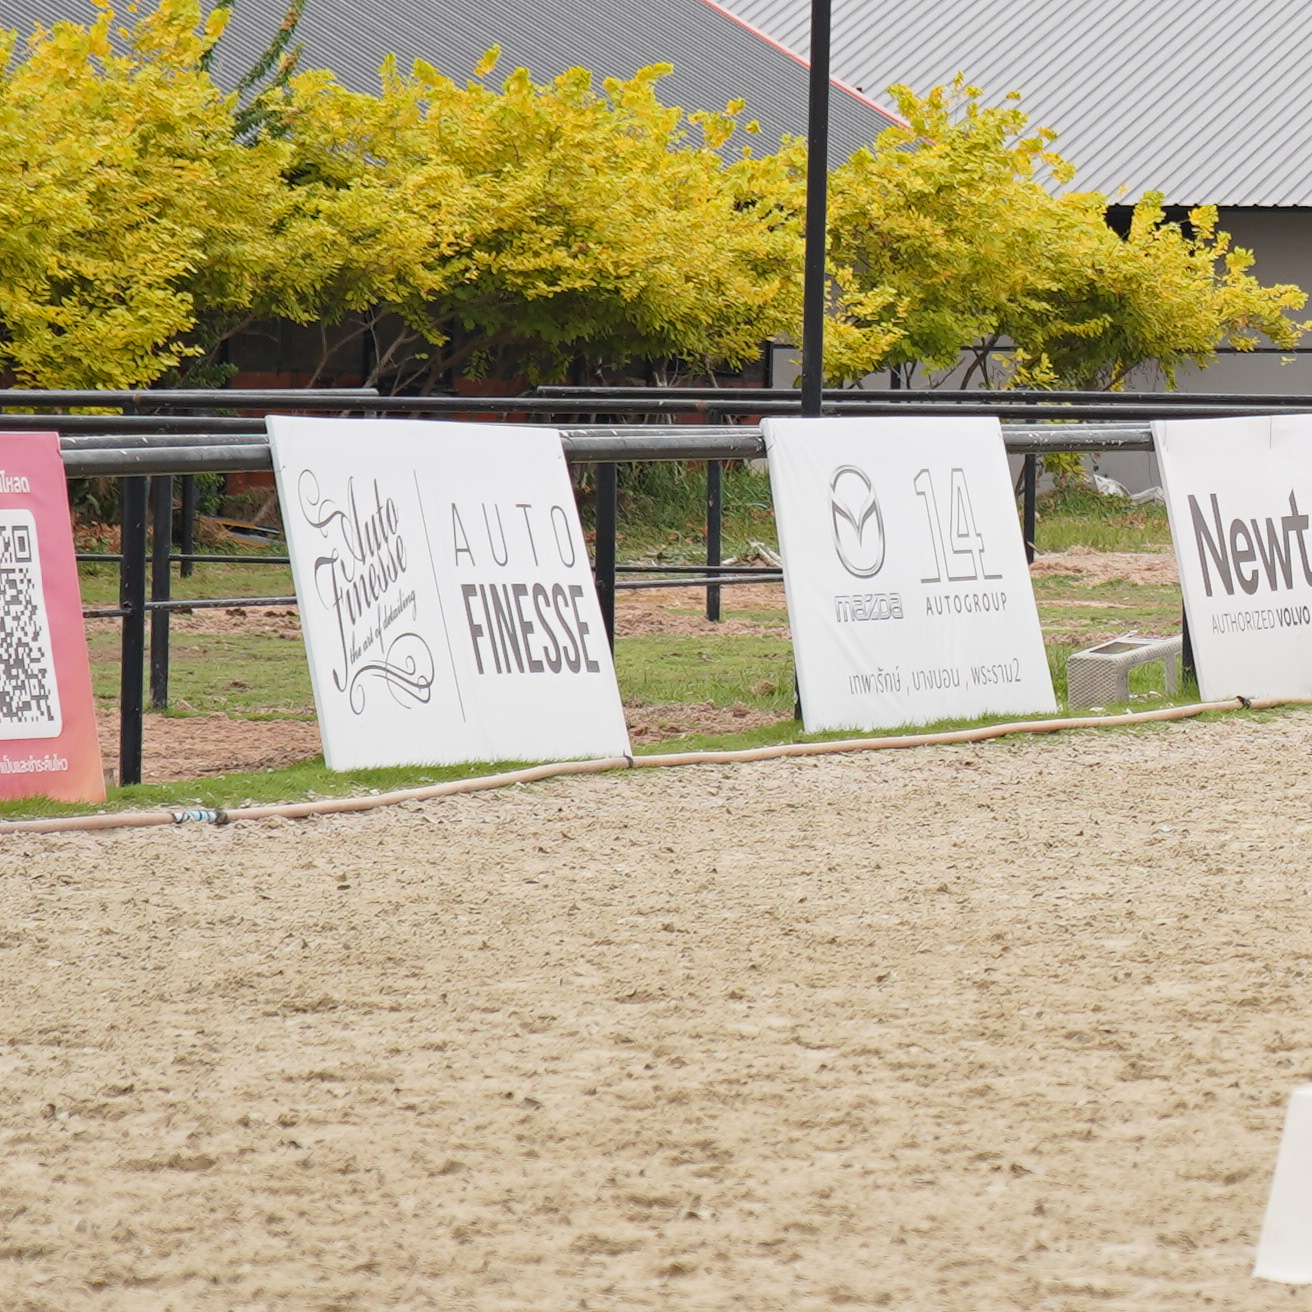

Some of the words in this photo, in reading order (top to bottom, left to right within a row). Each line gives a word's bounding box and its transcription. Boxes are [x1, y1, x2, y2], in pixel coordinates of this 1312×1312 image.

[299, 470, 399, 578] Auto
[452, 503, 575, 568] AUTO
[914, 468, 1003, 584] 14
[315, 535, 407, 692] Finesse
[350, 631, 362, 665] the
[363, 627, 374, 653] art
[375, 604, 385, 654] of
[382, 590, 417, 630] detailing
[461, 583, 600, 675] FINESSE
[926, 592, 1007, 615] AUTOGROUP
[1212, 609, 1275, 635] AUTHORIZED
[1276, 605, 1311, 628] VOLVO
